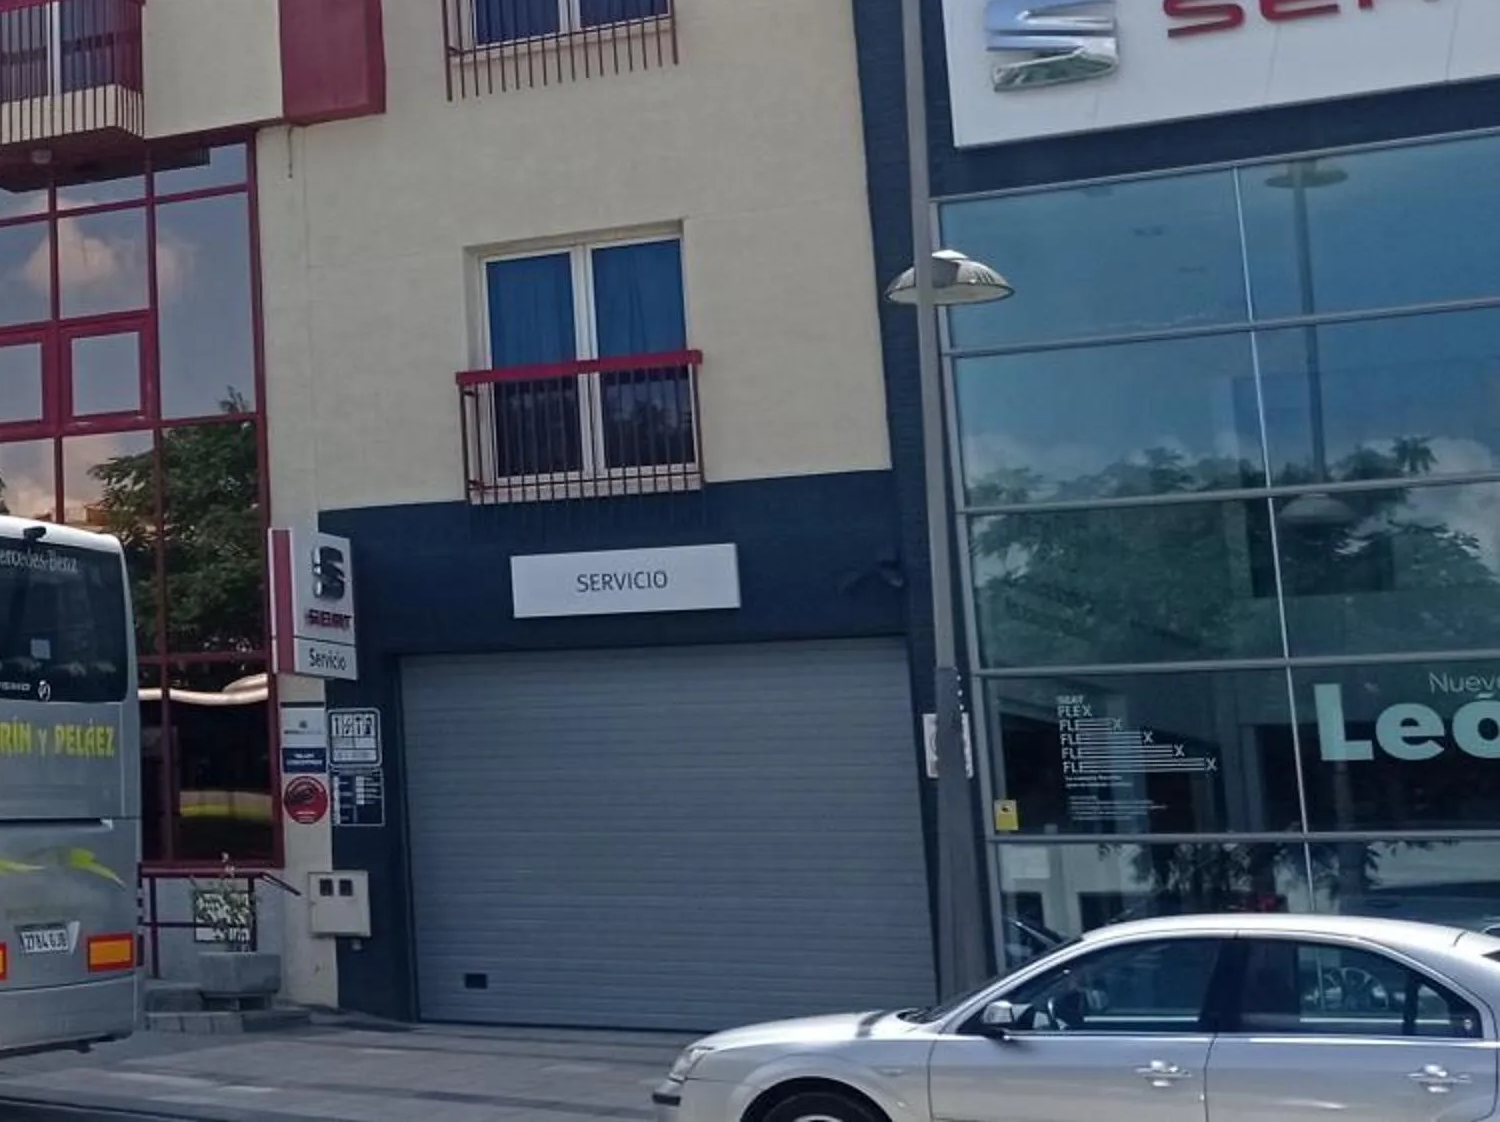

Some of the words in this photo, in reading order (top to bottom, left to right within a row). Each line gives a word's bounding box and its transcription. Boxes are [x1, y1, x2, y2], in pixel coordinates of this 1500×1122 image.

[576, 570, 669, 594] SERVICIO
[308, 647, 347, 671] Servicio
[1429, 672, 1500, 694] Nuev
[1058, 705, 1092, 717] FLEX
